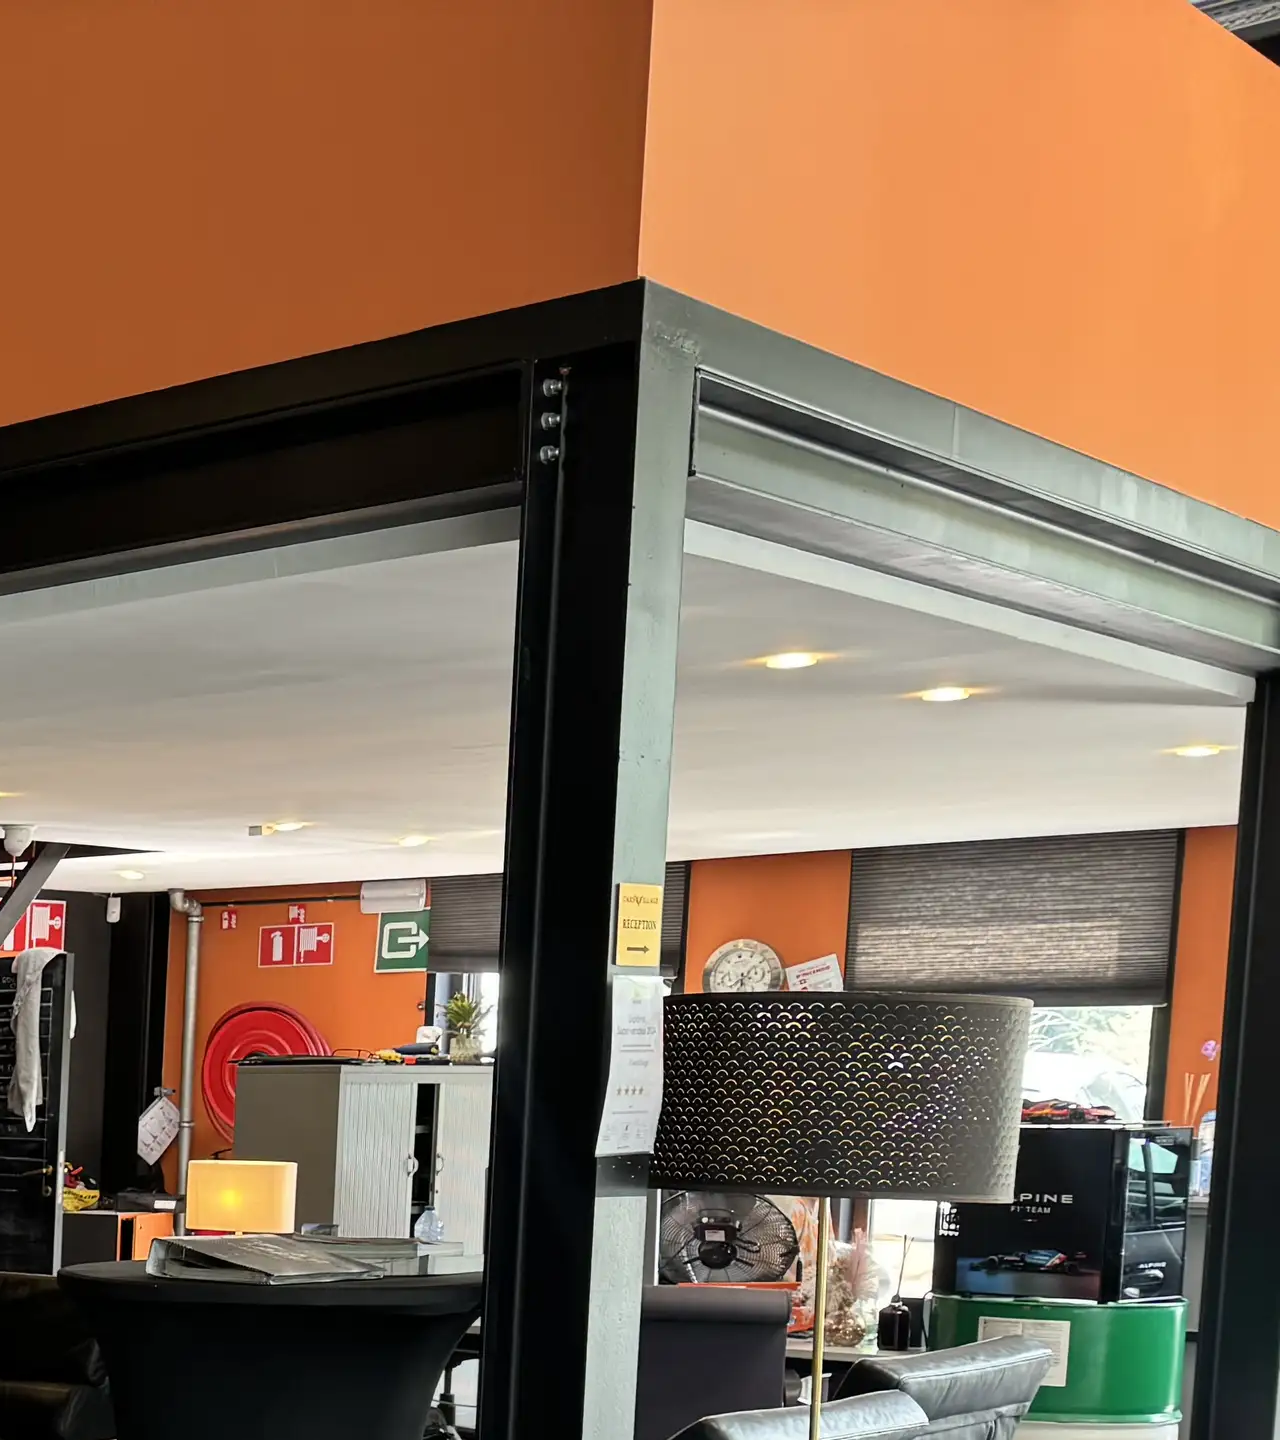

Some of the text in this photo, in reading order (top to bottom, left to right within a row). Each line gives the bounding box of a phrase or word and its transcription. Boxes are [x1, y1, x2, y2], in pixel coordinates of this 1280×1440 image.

[622, 918, 657, 930] RECEPTION
[1014, 1192, 1074, 1204] PINE
[1025, 1205, 1051, 1214] TEAM
